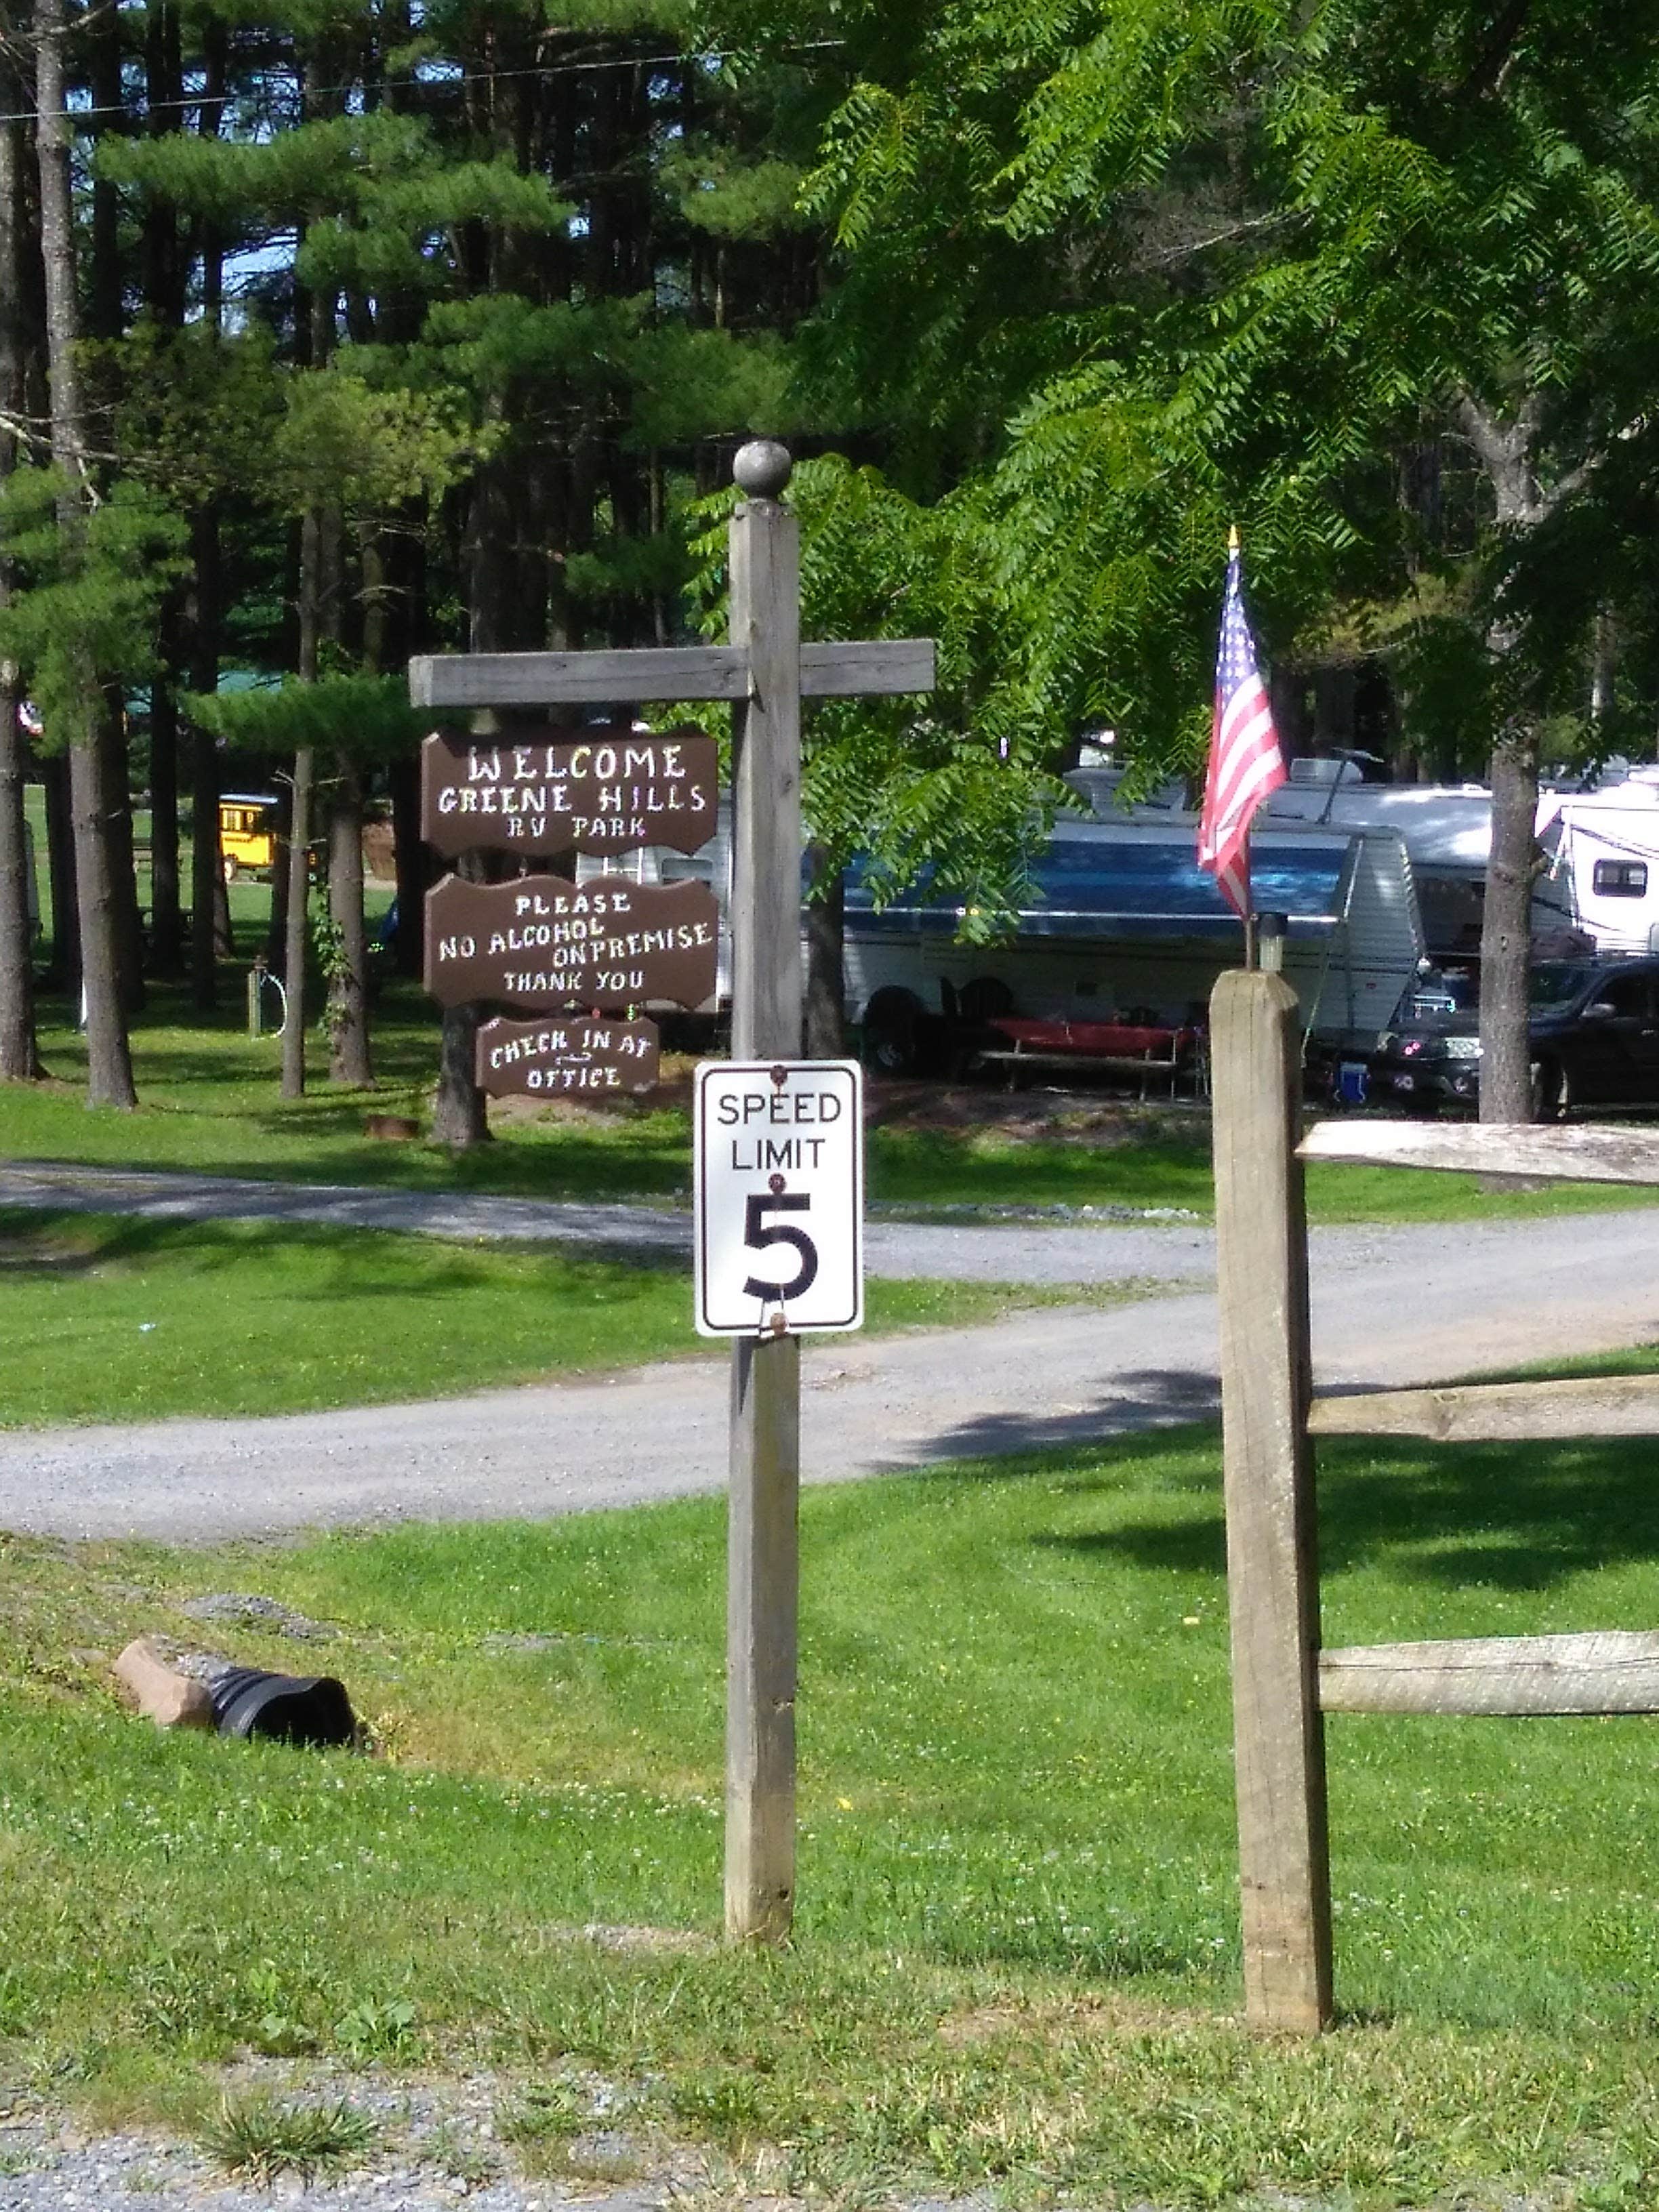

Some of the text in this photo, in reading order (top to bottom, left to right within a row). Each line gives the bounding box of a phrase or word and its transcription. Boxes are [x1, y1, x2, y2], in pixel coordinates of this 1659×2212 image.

[468, 745, 686, 781] WELCOME
[438, 785, 706, 813] GREENE HILLS
[507, 817, 646, 838] RV PARK
[515, 894, 631, 916] PLEASE
[439, 916, 605, 961] NO ALCOHOL
[554, 922, 712, 968] ON PREMISE
[504, 971, 645, 991] THANK YOU
[490, 1030, 652, 1069] CHECK IN AT
[527, 1068, 621, 1088] OFFICE
[718, 1093, 841, 1124] SPEED
[732, 1139, 825, 1170] LIMIT
[743, 1193, 818, 1302] 5
